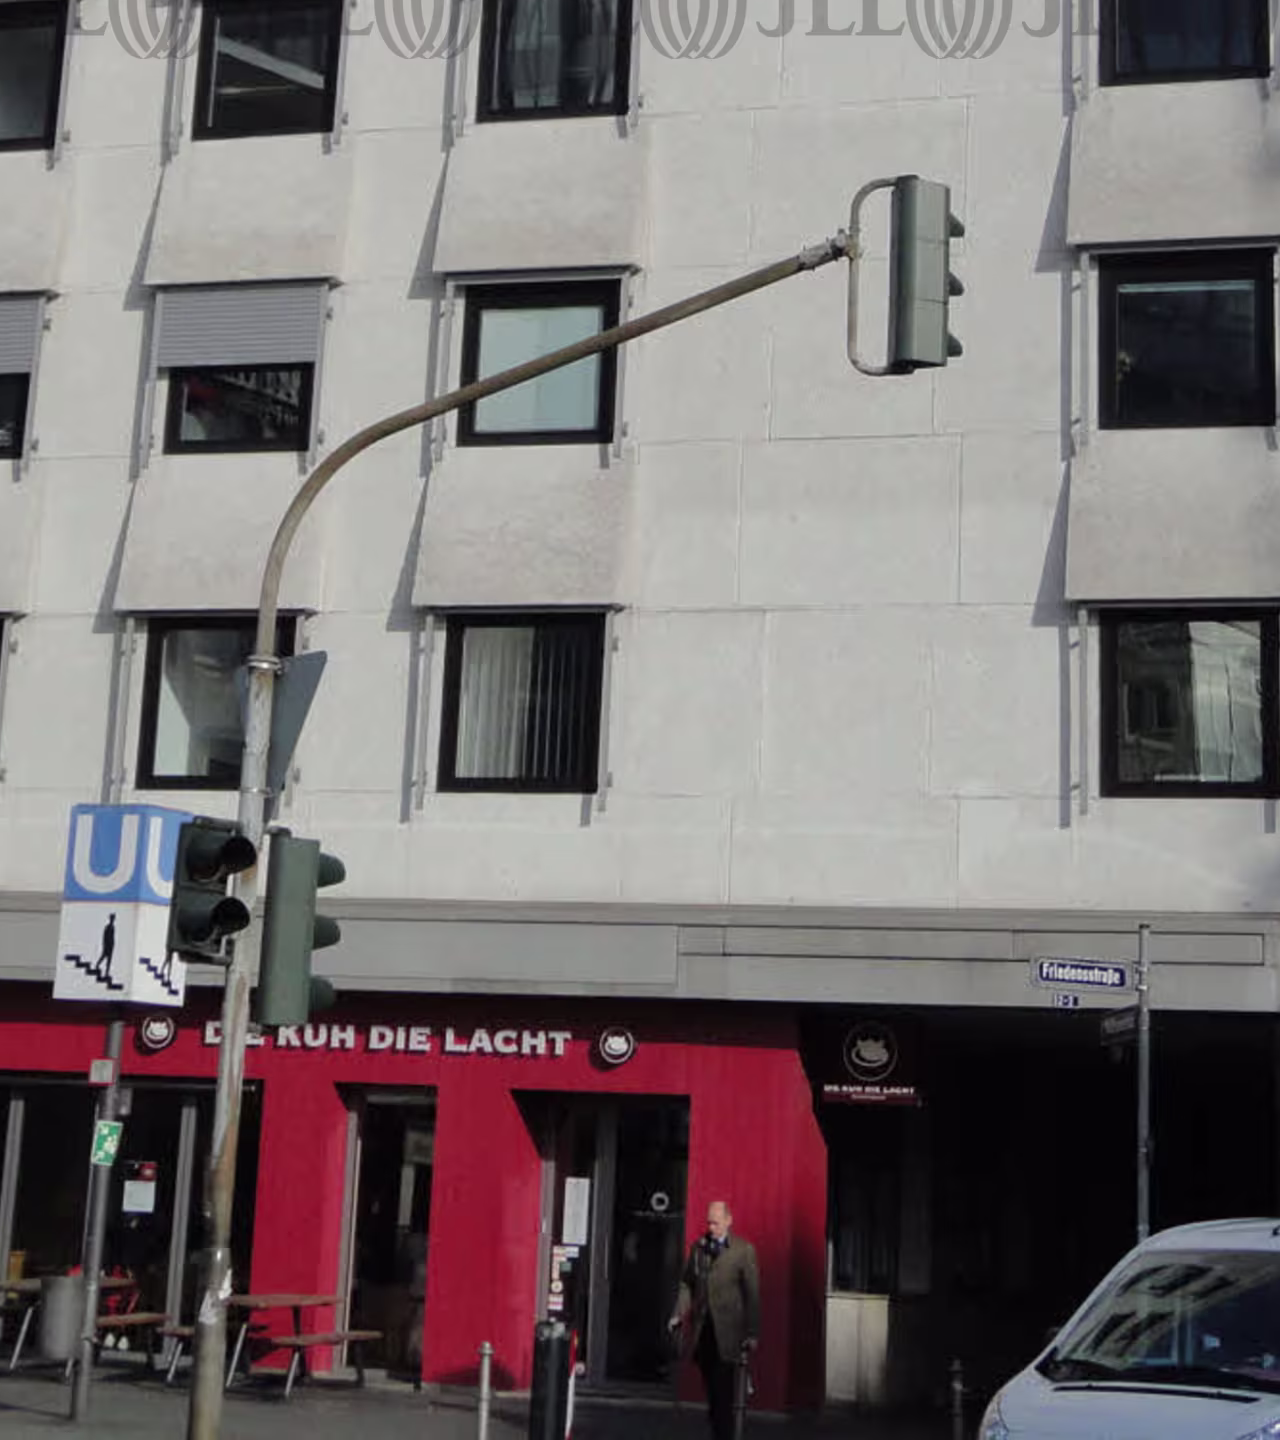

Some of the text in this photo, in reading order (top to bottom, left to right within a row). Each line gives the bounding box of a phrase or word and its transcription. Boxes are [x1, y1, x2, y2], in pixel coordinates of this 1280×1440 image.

[73, 814, 140, 894] U
[1042, 962, 1121, 986] Friedensstraße
[204, 1020, 573, 1056] DE KUH DIE LACHT
